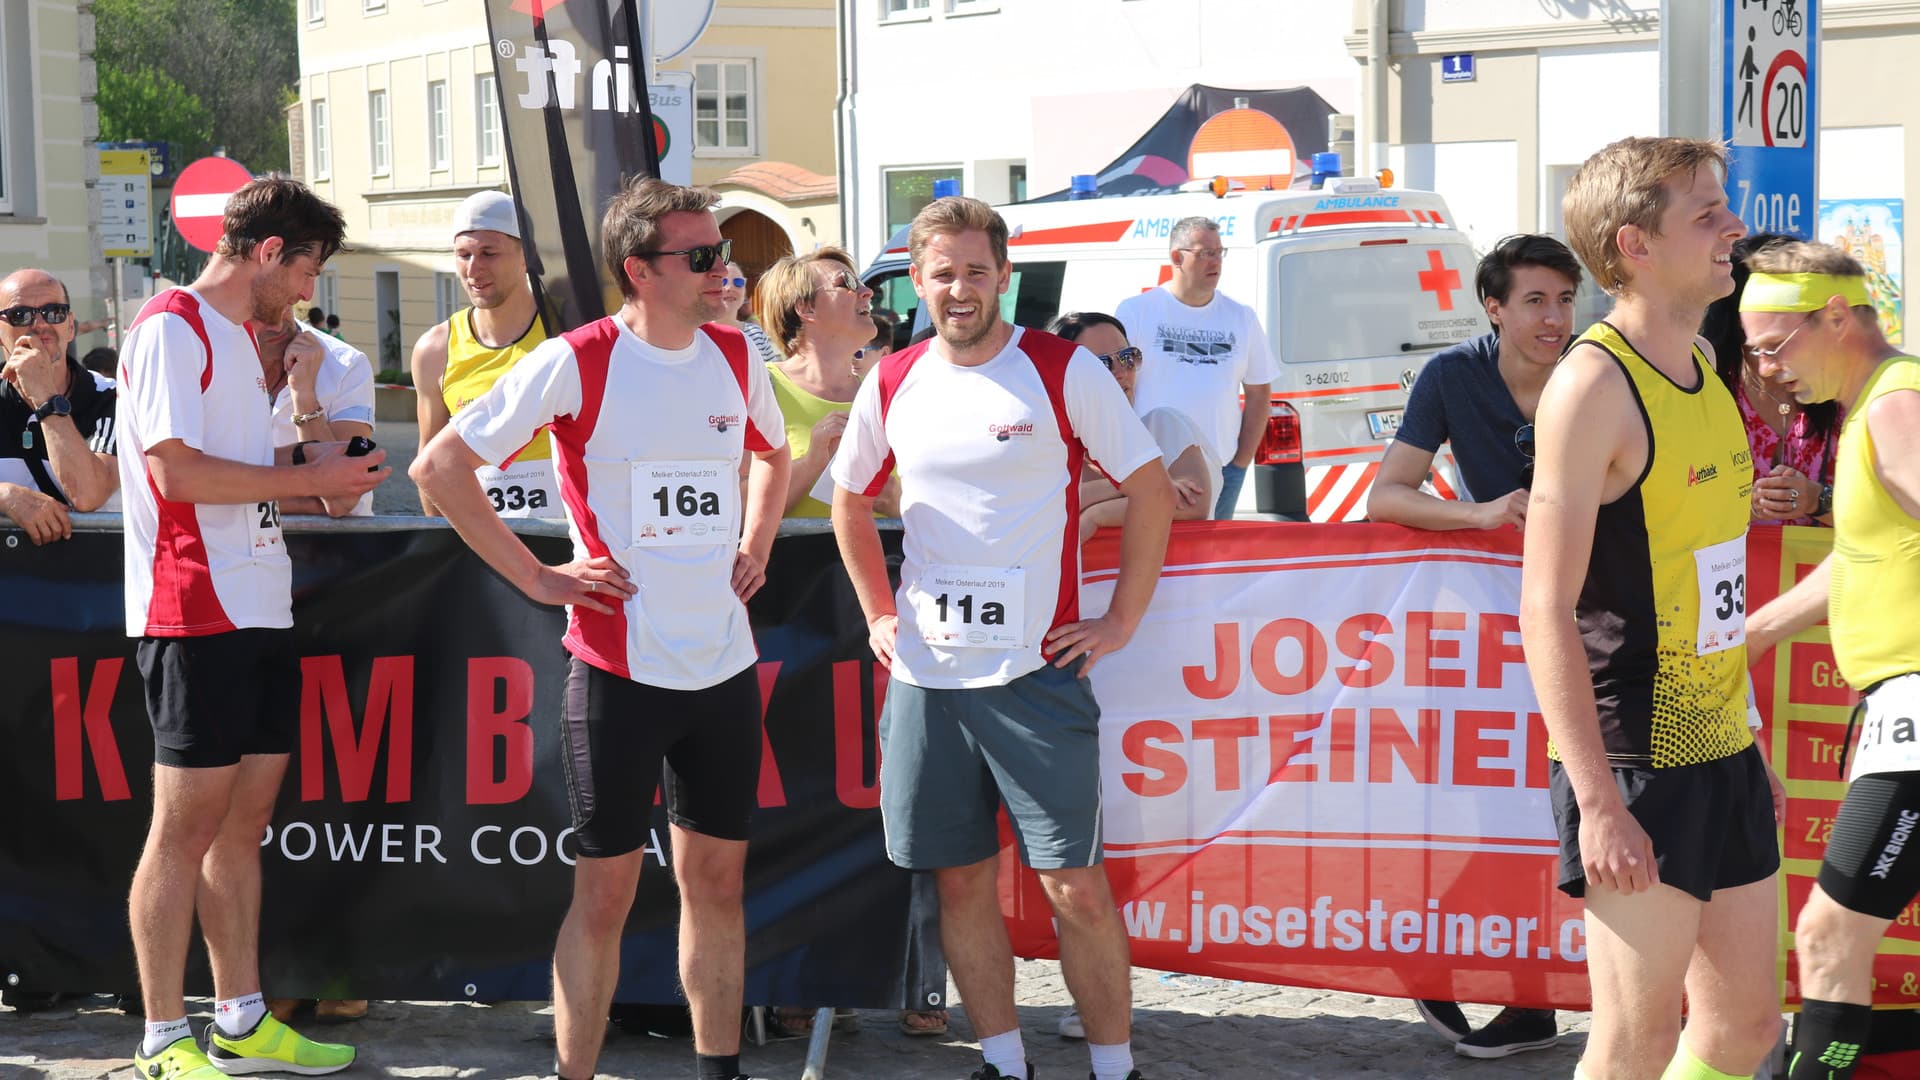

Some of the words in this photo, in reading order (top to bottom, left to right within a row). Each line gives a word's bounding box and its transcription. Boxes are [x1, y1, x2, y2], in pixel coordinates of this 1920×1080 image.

[1452, 56, 1461, 71] 1
[648, 93, 681, 105] Bus
[1776, 82, 1803, 139] 20
[1315, 196, 1399, 210] AMBULANCE
[1737, 179, 1801, 234] Zone
[1133, 216, 1236, 240] AMBCE
[1305, 371, 1350, 386] 3-62/012
[708, 415, 740, 425] Gottwald
[988, 423, 1033, 433] Gottwald
[530, 471, 545, 479] 2019
[651, 471, 673, 479] Melker
[674, 470, 701, 478] Osterlauf
[702, 470, 718, 478] 2019
[486, 485, 548, 512] 33a
[652, 485, 720, 517] 16a
[955, 579, 987, 587] Osterlauf
[1715, 574, 1745, 621] 33
[935, 593, 1006, 626] 11a
[1182, 611, 1529, 700] JOSEF
